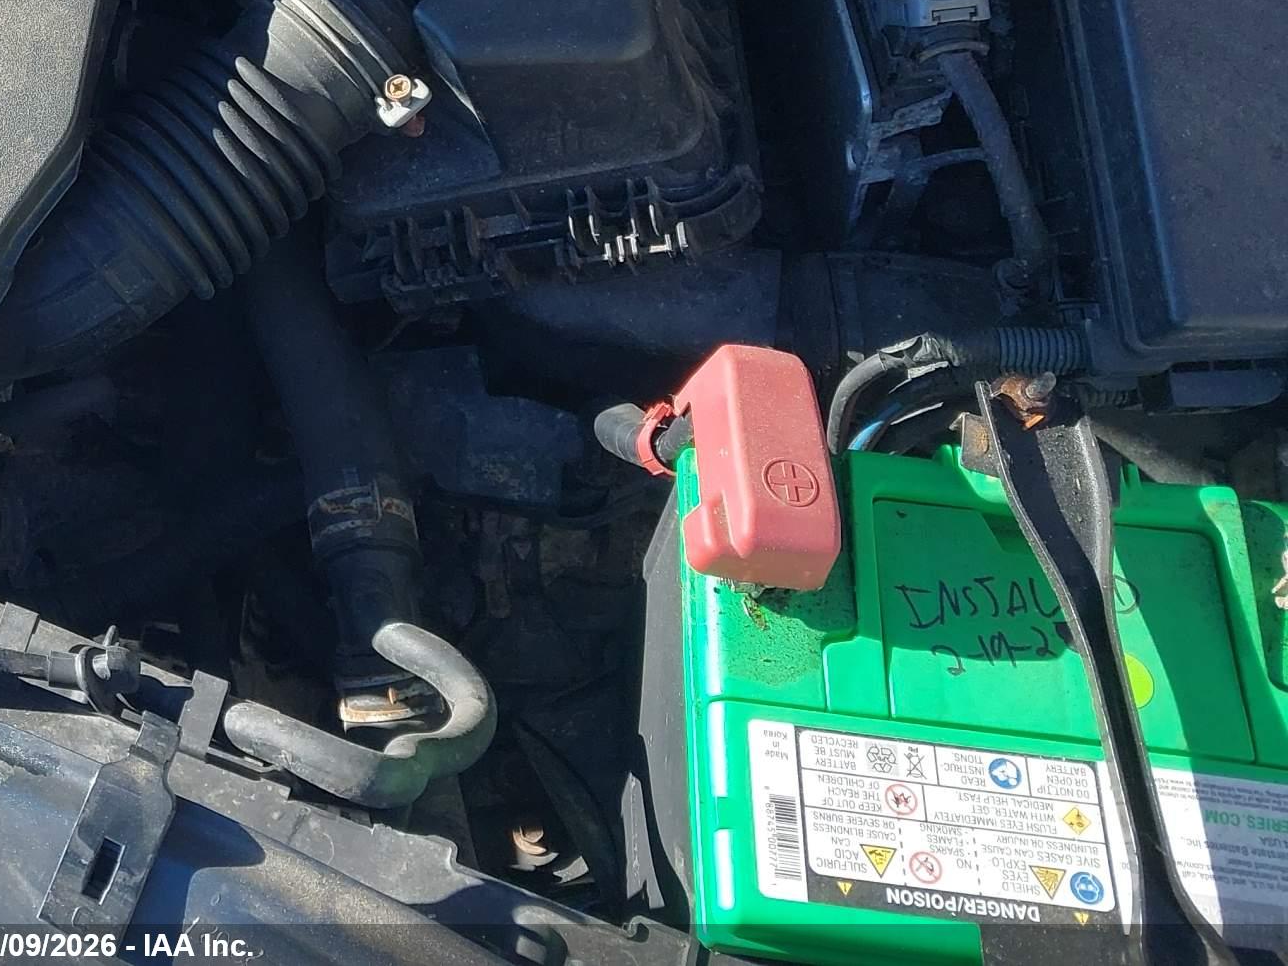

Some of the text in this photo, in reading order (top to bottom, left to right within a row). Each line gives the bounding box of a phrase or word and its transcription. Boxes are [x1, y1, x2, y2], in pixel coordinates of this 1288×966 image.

[763, 729, 787, 740] Korea
[772, 741, 779, 749] in
[764, 750, 789, 762] Made
[813, 745, 855, 759] MUST BE
[815, 757, 857, 770] BATTERY
[868, 781, 880, 790] OF
[961, 775, 986, 787] READ
[1046, 774, 1088, 788] OR OPEN
[827, 786, 881, 801] THE REACH
[1037, 784, 1090, 799] DO NOT TIP
[821, 797, 882, 812] KEEP OUT OF
[984, 795, 1008, 807] HELP
[1010, 797, 1054, 811] MEDICAL
[971, 805, 990, 815] GET
[846, 816, 880, 828] SEVERE
[933, 811, 1057, 835] FLUSH EYES IMMEDIATELY
[1030, 811, 1056, 823] WITH
[813, 822, 897, 841] CAUSE BLINDNESS
[883, 820, 895, 830] OR
[831, 836, 851, 847] CAN
[1030, 839, 1044, 849] OR
[1045, 840, 1099, 854] BLINDNESS
[834, 848, 859, 861] ACID
[981, 844, 1100, 869] SIVE GASES CAN CAUSE
[815, 857, 867, 874] SULFURIC
[956, 858, 972, 870] NO
[1001, 881, 1041, 895] SHIELD
[886, 887, 1041, 923] DANGER/POISON
